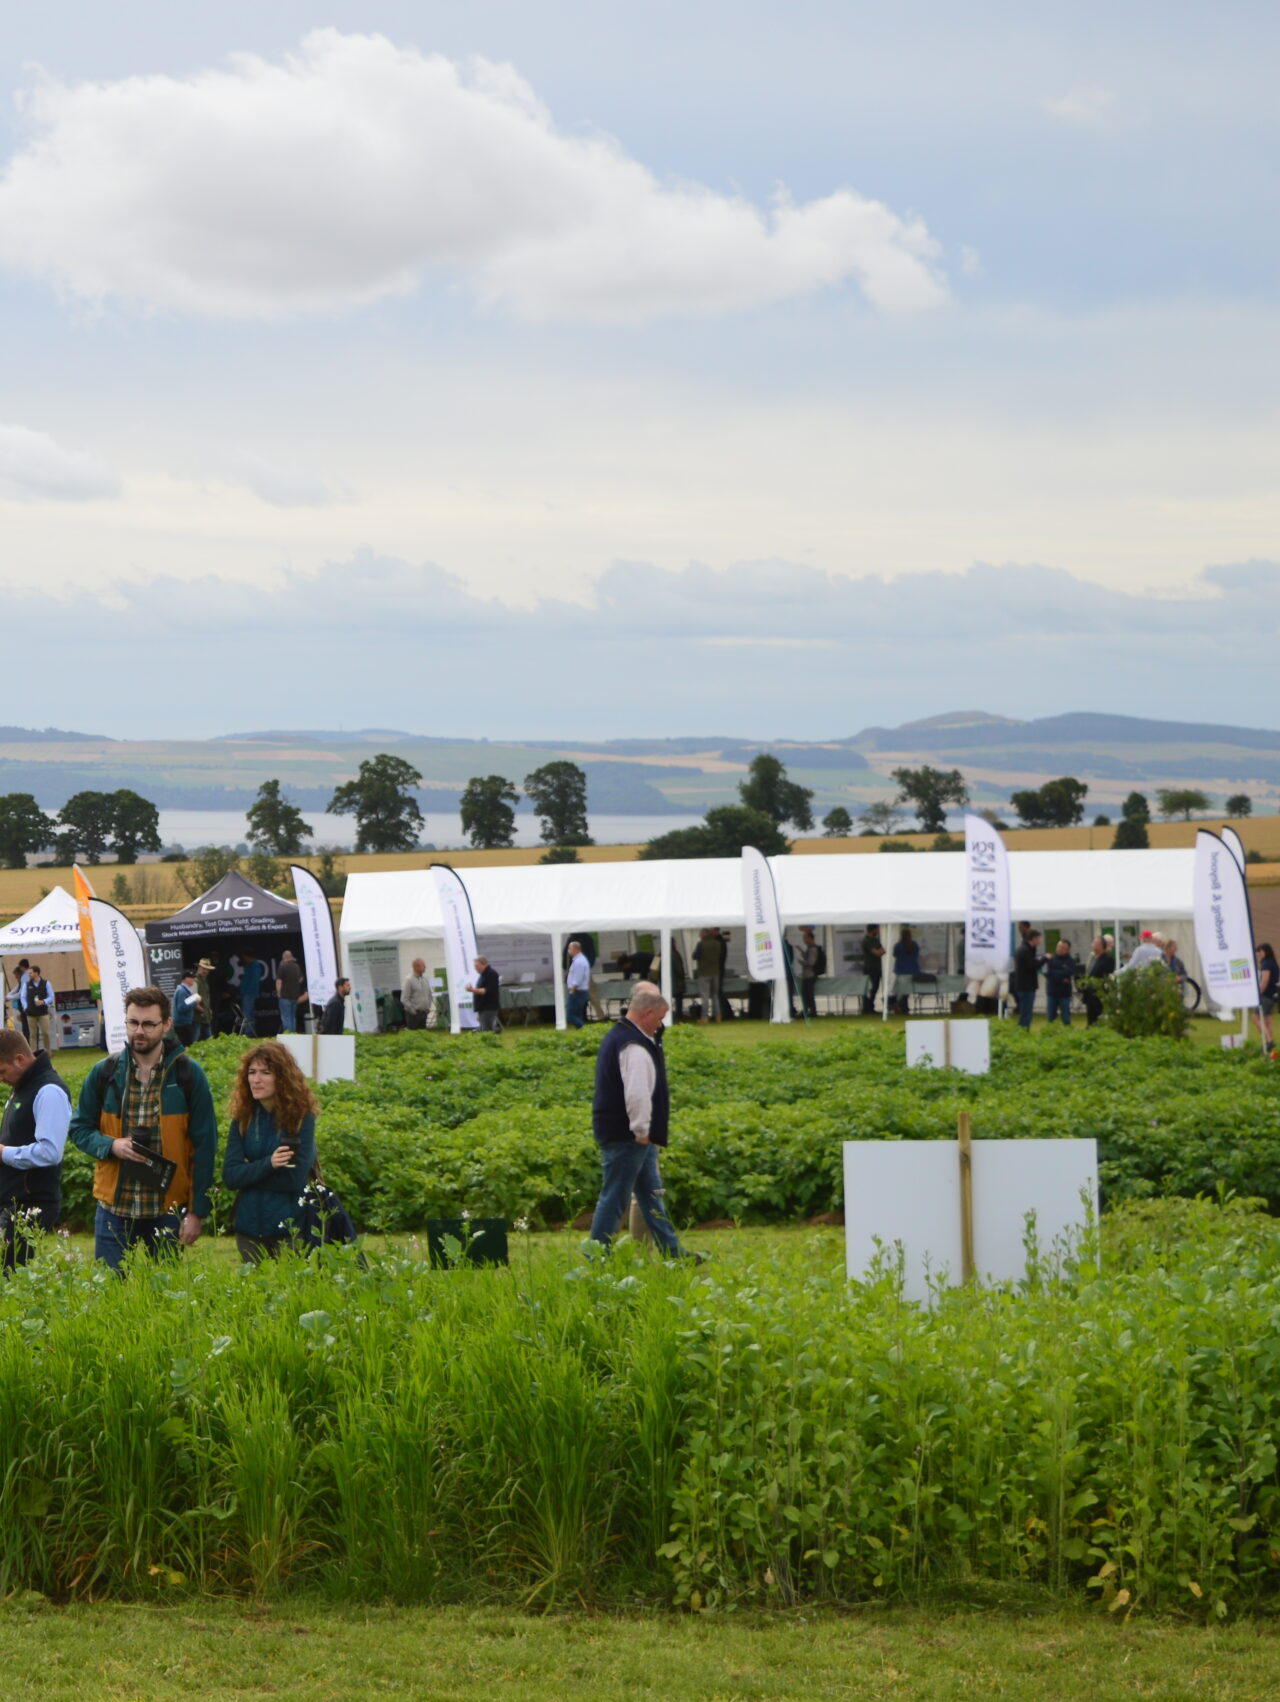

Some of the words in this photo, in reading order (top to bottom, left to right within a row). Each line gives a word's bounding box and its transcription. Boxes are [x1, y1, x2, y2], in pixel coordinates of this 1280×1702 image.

[200, 896, 254, 915] DIG
[10, 921, 81, 936] syngent
[163, 949, 181, 960] DIG
